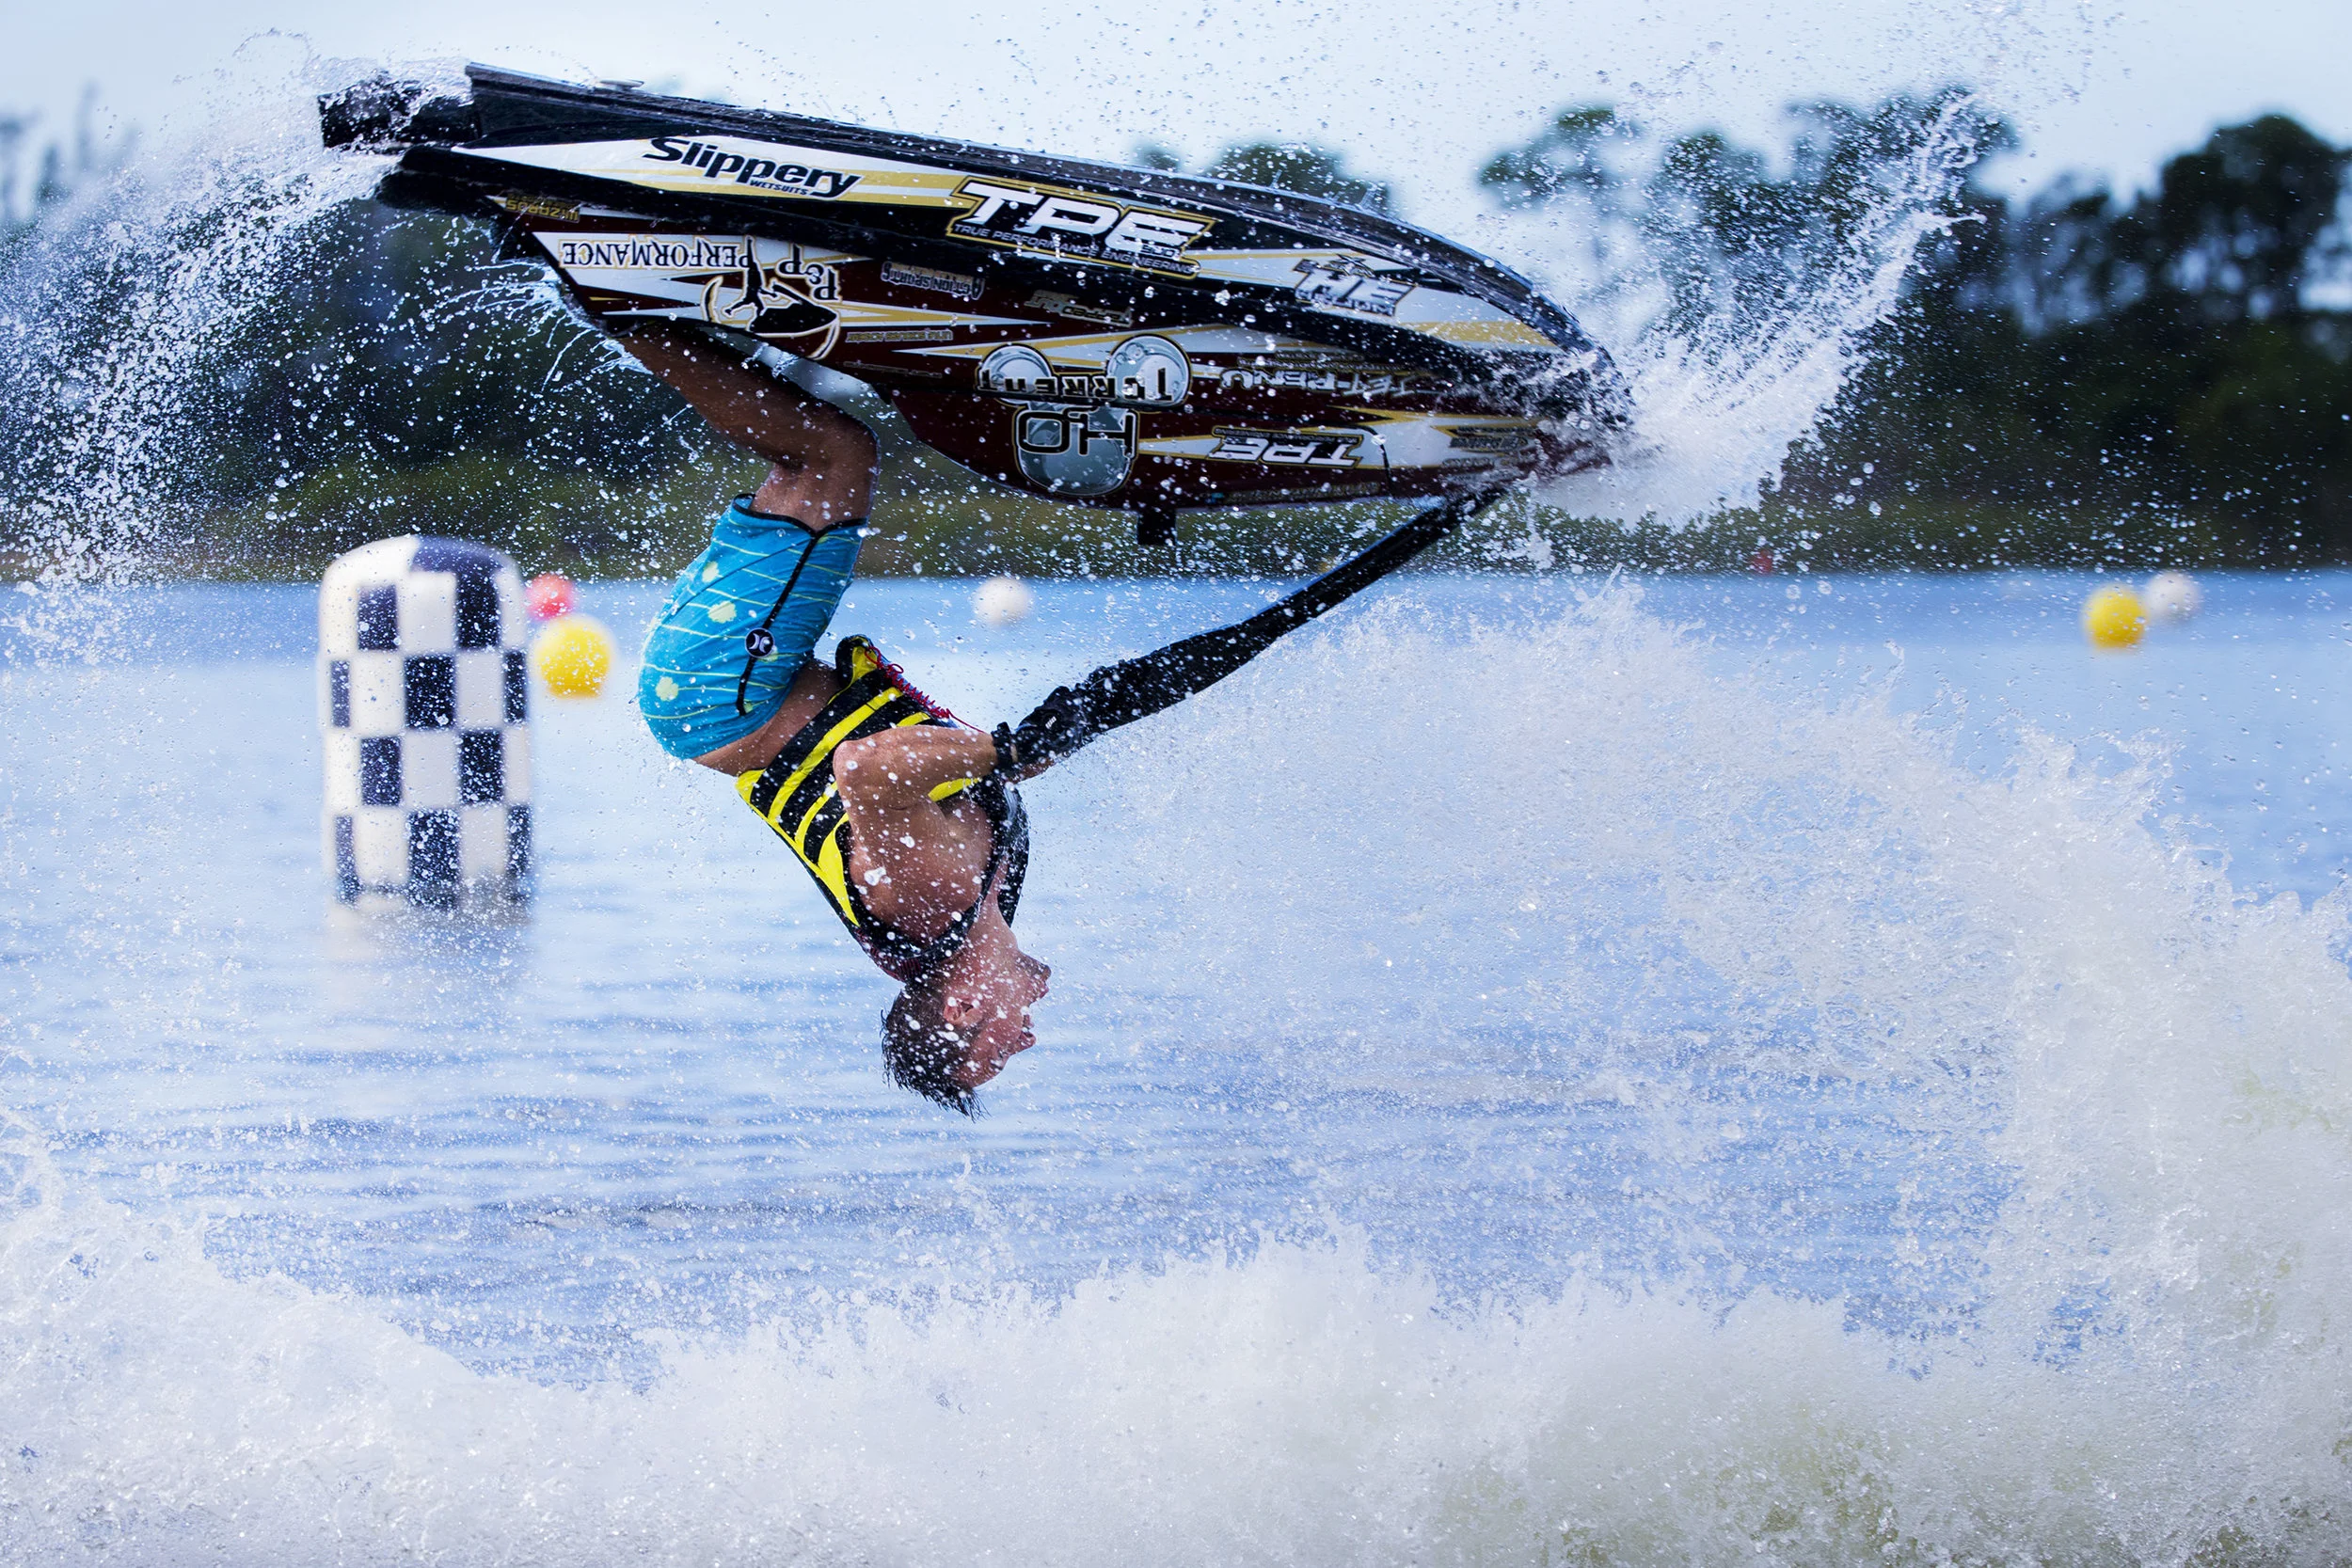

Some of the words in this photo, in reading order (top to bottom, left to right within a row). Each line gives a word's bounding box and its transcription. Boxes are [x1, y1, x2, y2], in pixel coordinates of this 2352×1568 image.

[642, 137, 860, 198] Slippery
[749, 179, 809, 196] WETSUITS
[961, 182, 1205, 255] TPE
[564, 236, 754, 267] PERFORMANCE
[954, 224, 990, 238] TRUE
[993, 230, 1098, 258] PERFORMANCE
[1101, 249, 1200, 275] ENGINEERING
[1208, 437, 1356, 467] TPE
